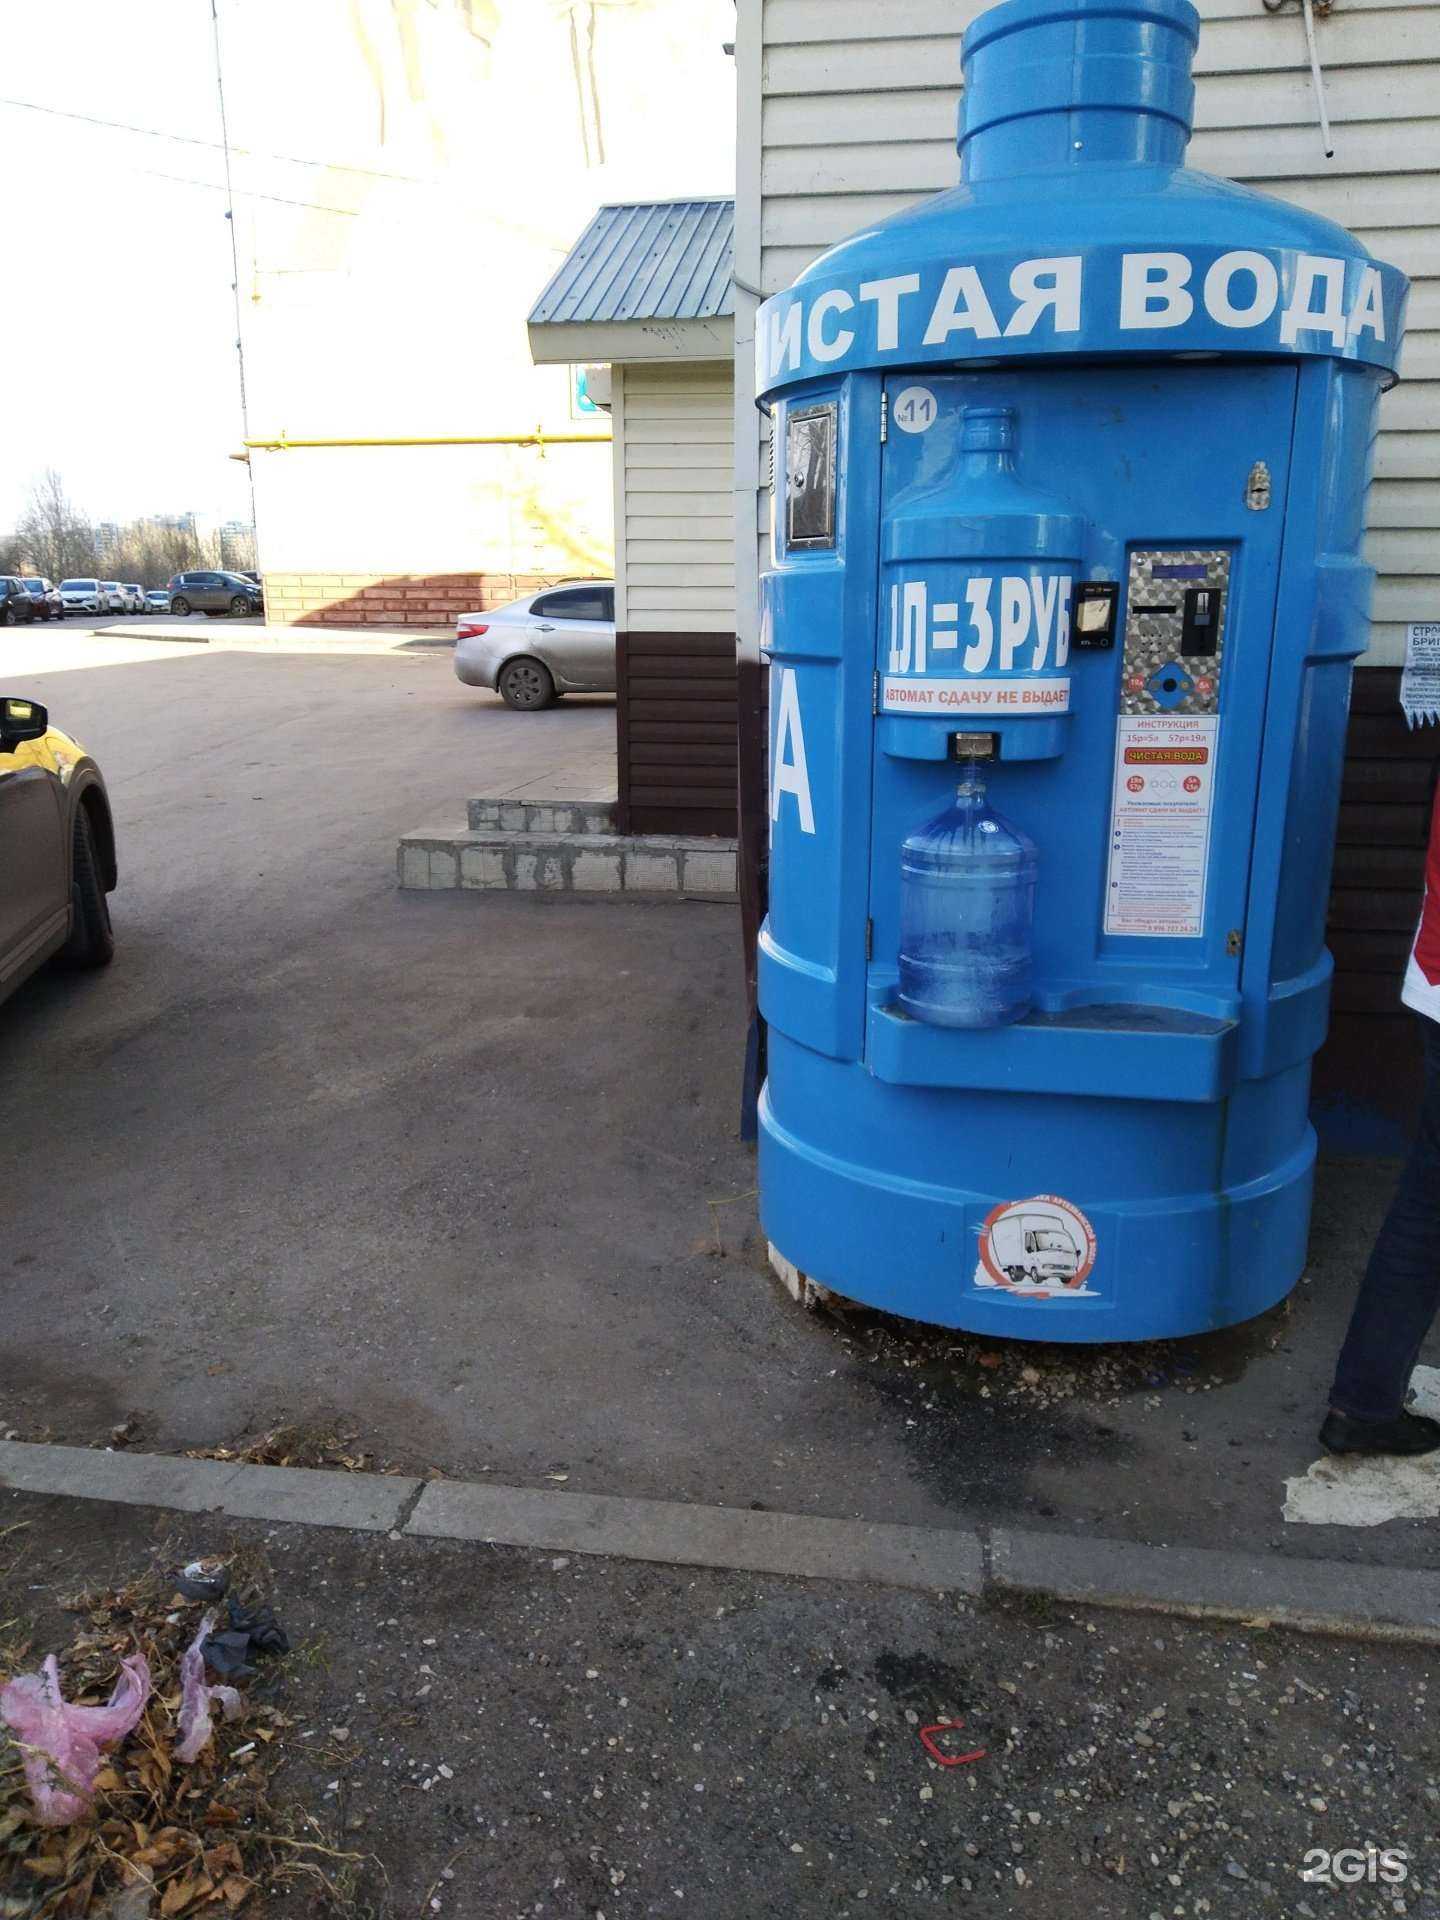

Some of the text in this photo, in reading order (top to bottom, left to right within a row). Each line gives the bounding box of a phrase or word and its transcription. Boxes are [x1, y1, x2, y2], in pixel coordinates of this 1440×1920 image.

[768, 250, 1387, 378] ИСТАЯ ВОДА
[1413, 626, 1440, 637] СТРО
[886, 689, 1069, 706] АВТОМАТ СДАЧУ НЕ ВЫДАЕТ
[1137, 720, 1200, 730] ИНСТРУКЦИЯ
[1129, 751, 1202, 761] ЧИСТАЯ ВОДА
